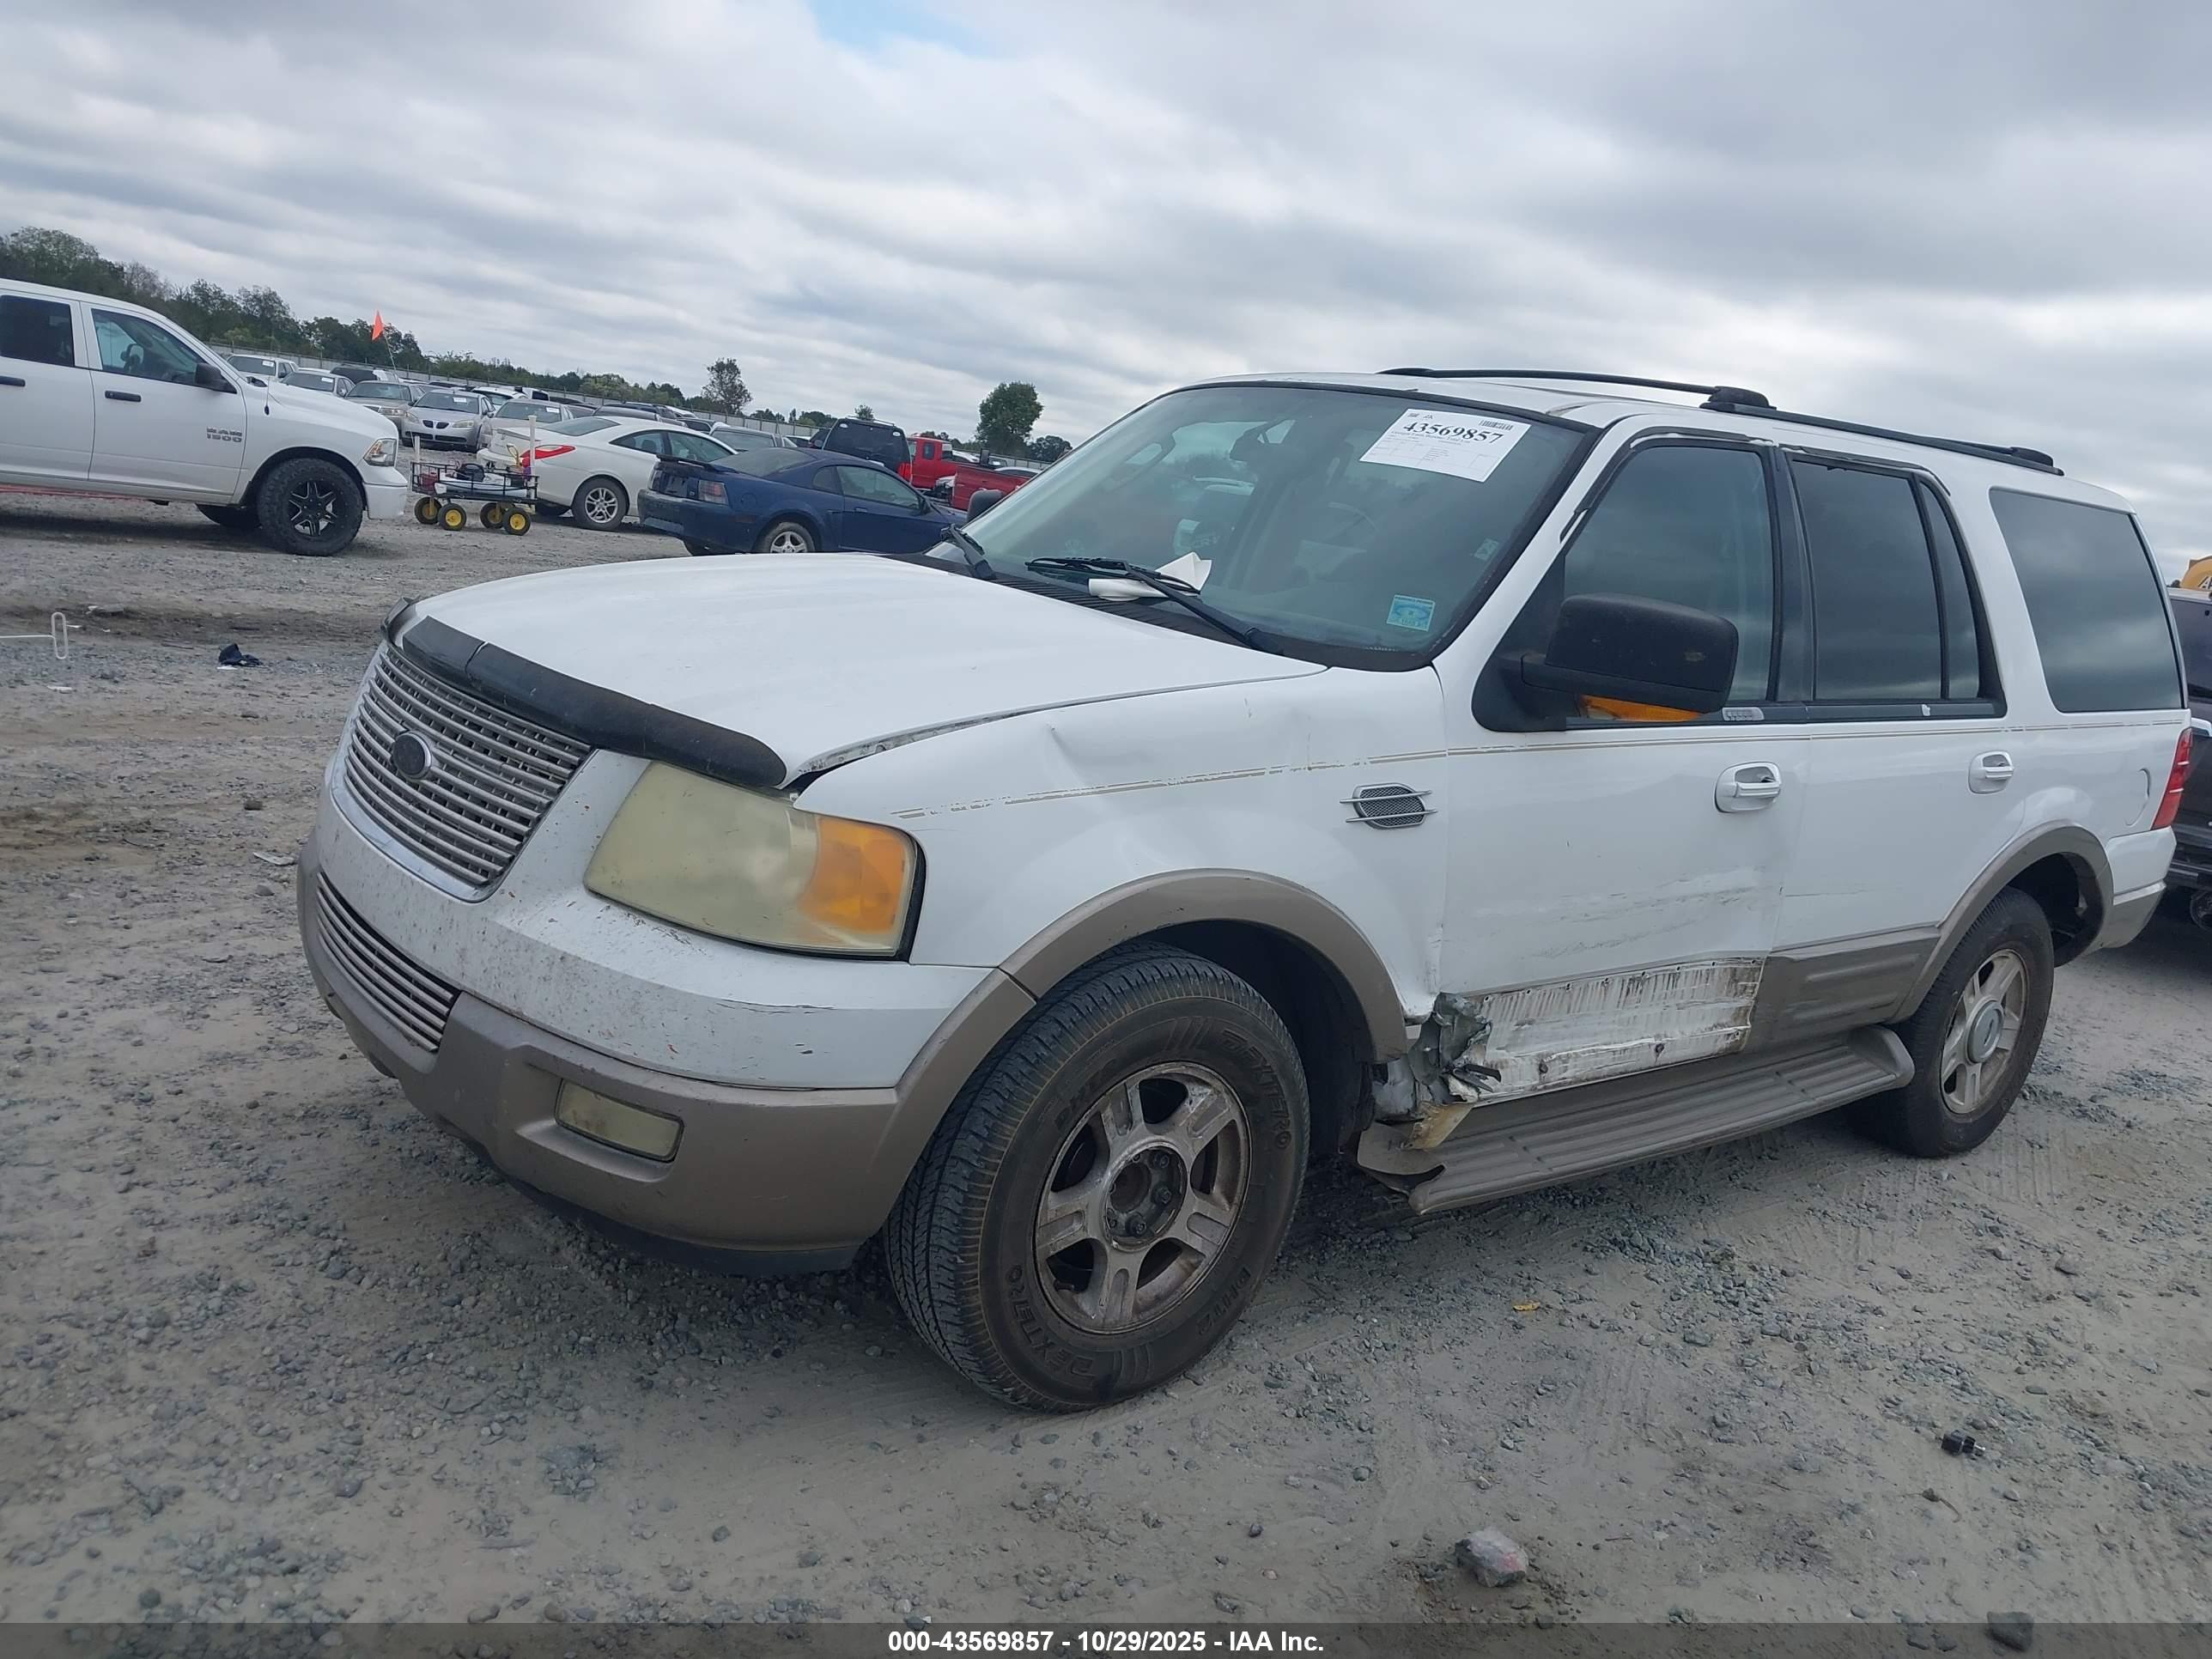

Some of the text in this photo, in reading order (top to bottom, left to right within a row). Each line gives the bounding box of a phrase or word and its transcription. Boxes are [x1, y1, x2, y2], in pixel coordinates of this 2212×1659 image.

[206, 434, 242, 442] 1500
[1402, 422, 1504, 444] 43569857
[1006, 1264, 1096, 1375] DEXTERO
